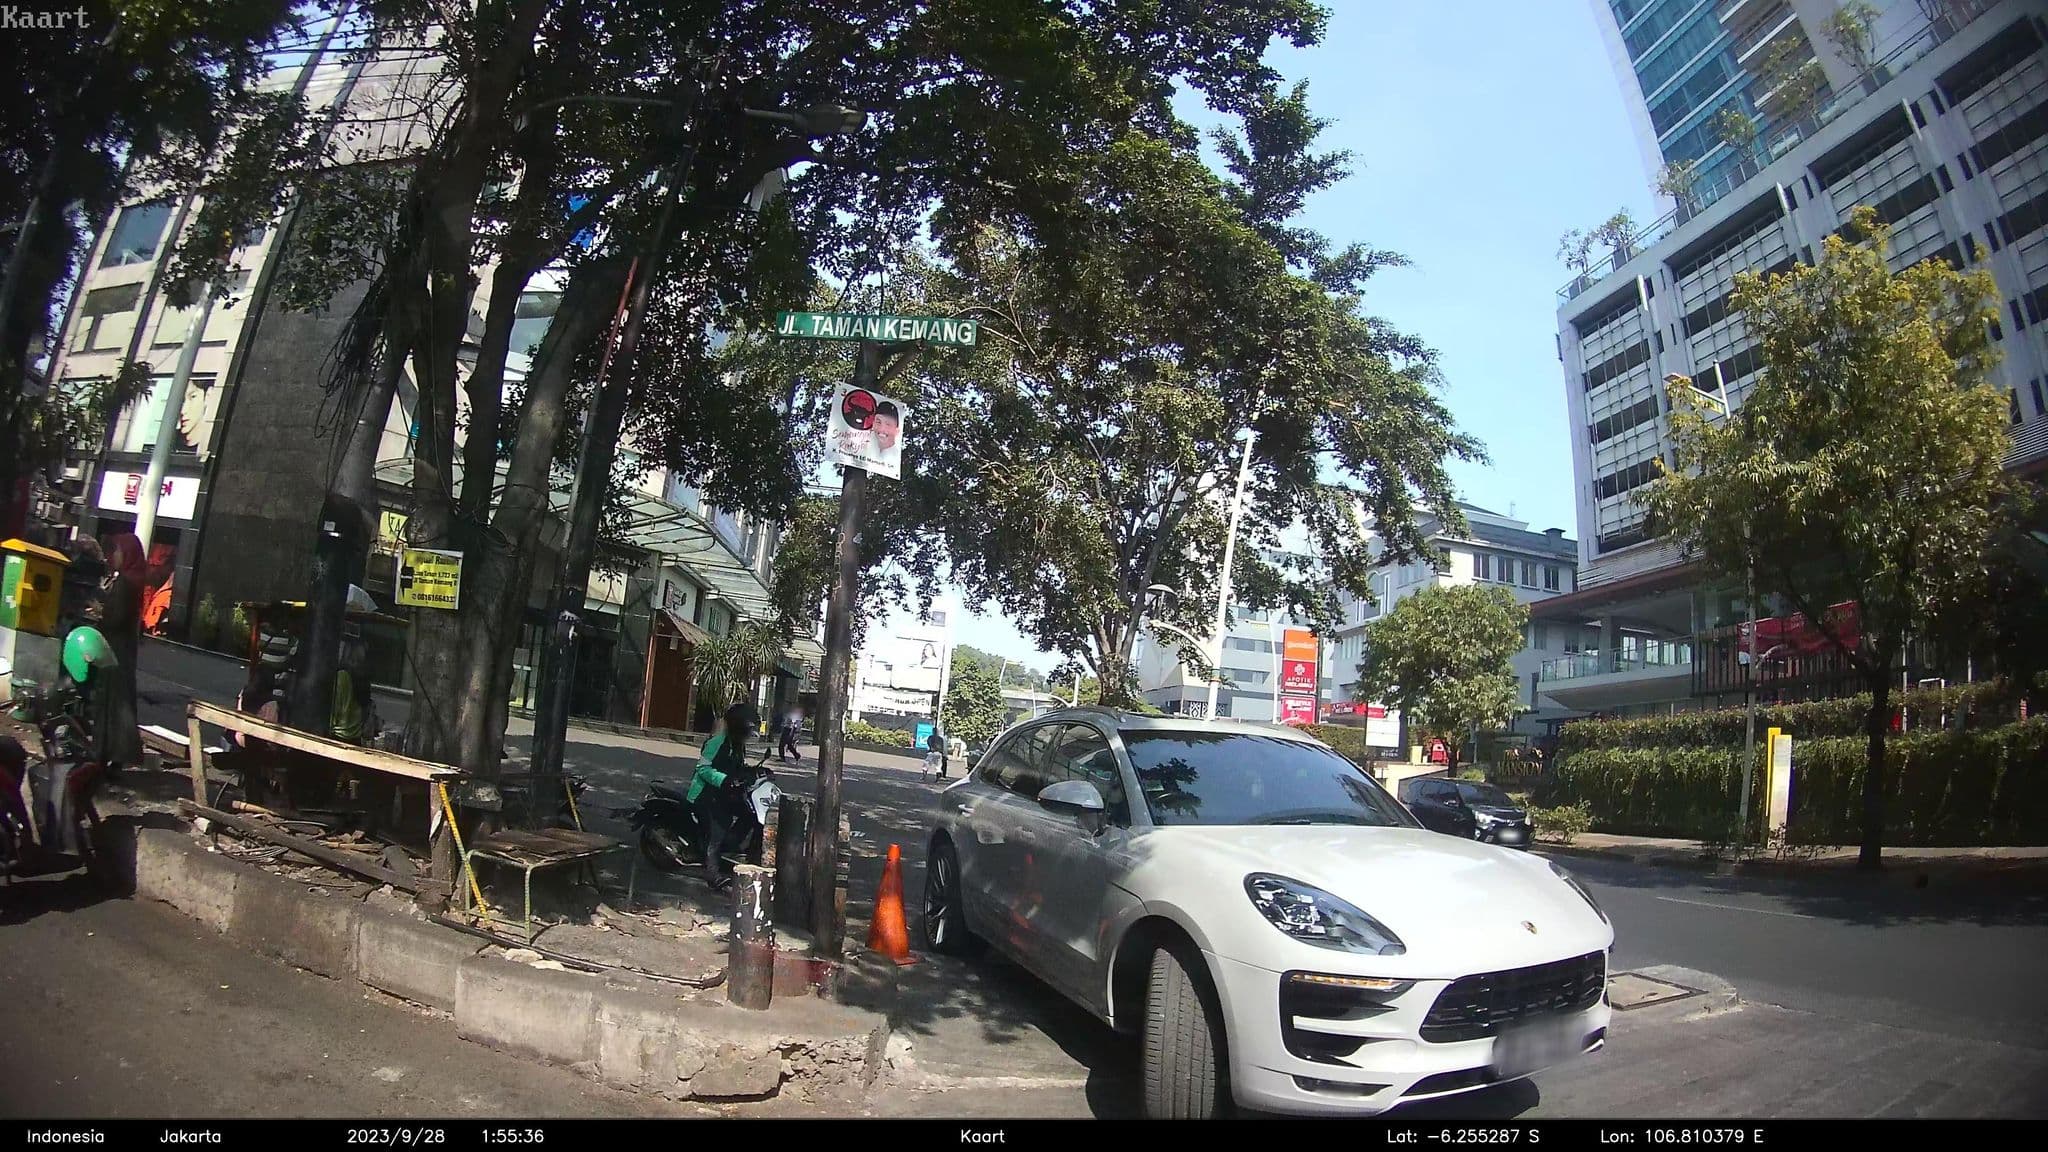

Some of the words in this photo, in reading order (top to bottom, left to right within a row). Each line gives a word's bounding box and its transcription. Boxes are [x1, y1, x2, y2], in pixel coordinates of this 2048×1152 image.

[778, 315, 804, 335] JL.
[811, 316, 880, 338] TAMAN
[884, 319, 973, 343] KEMANG
